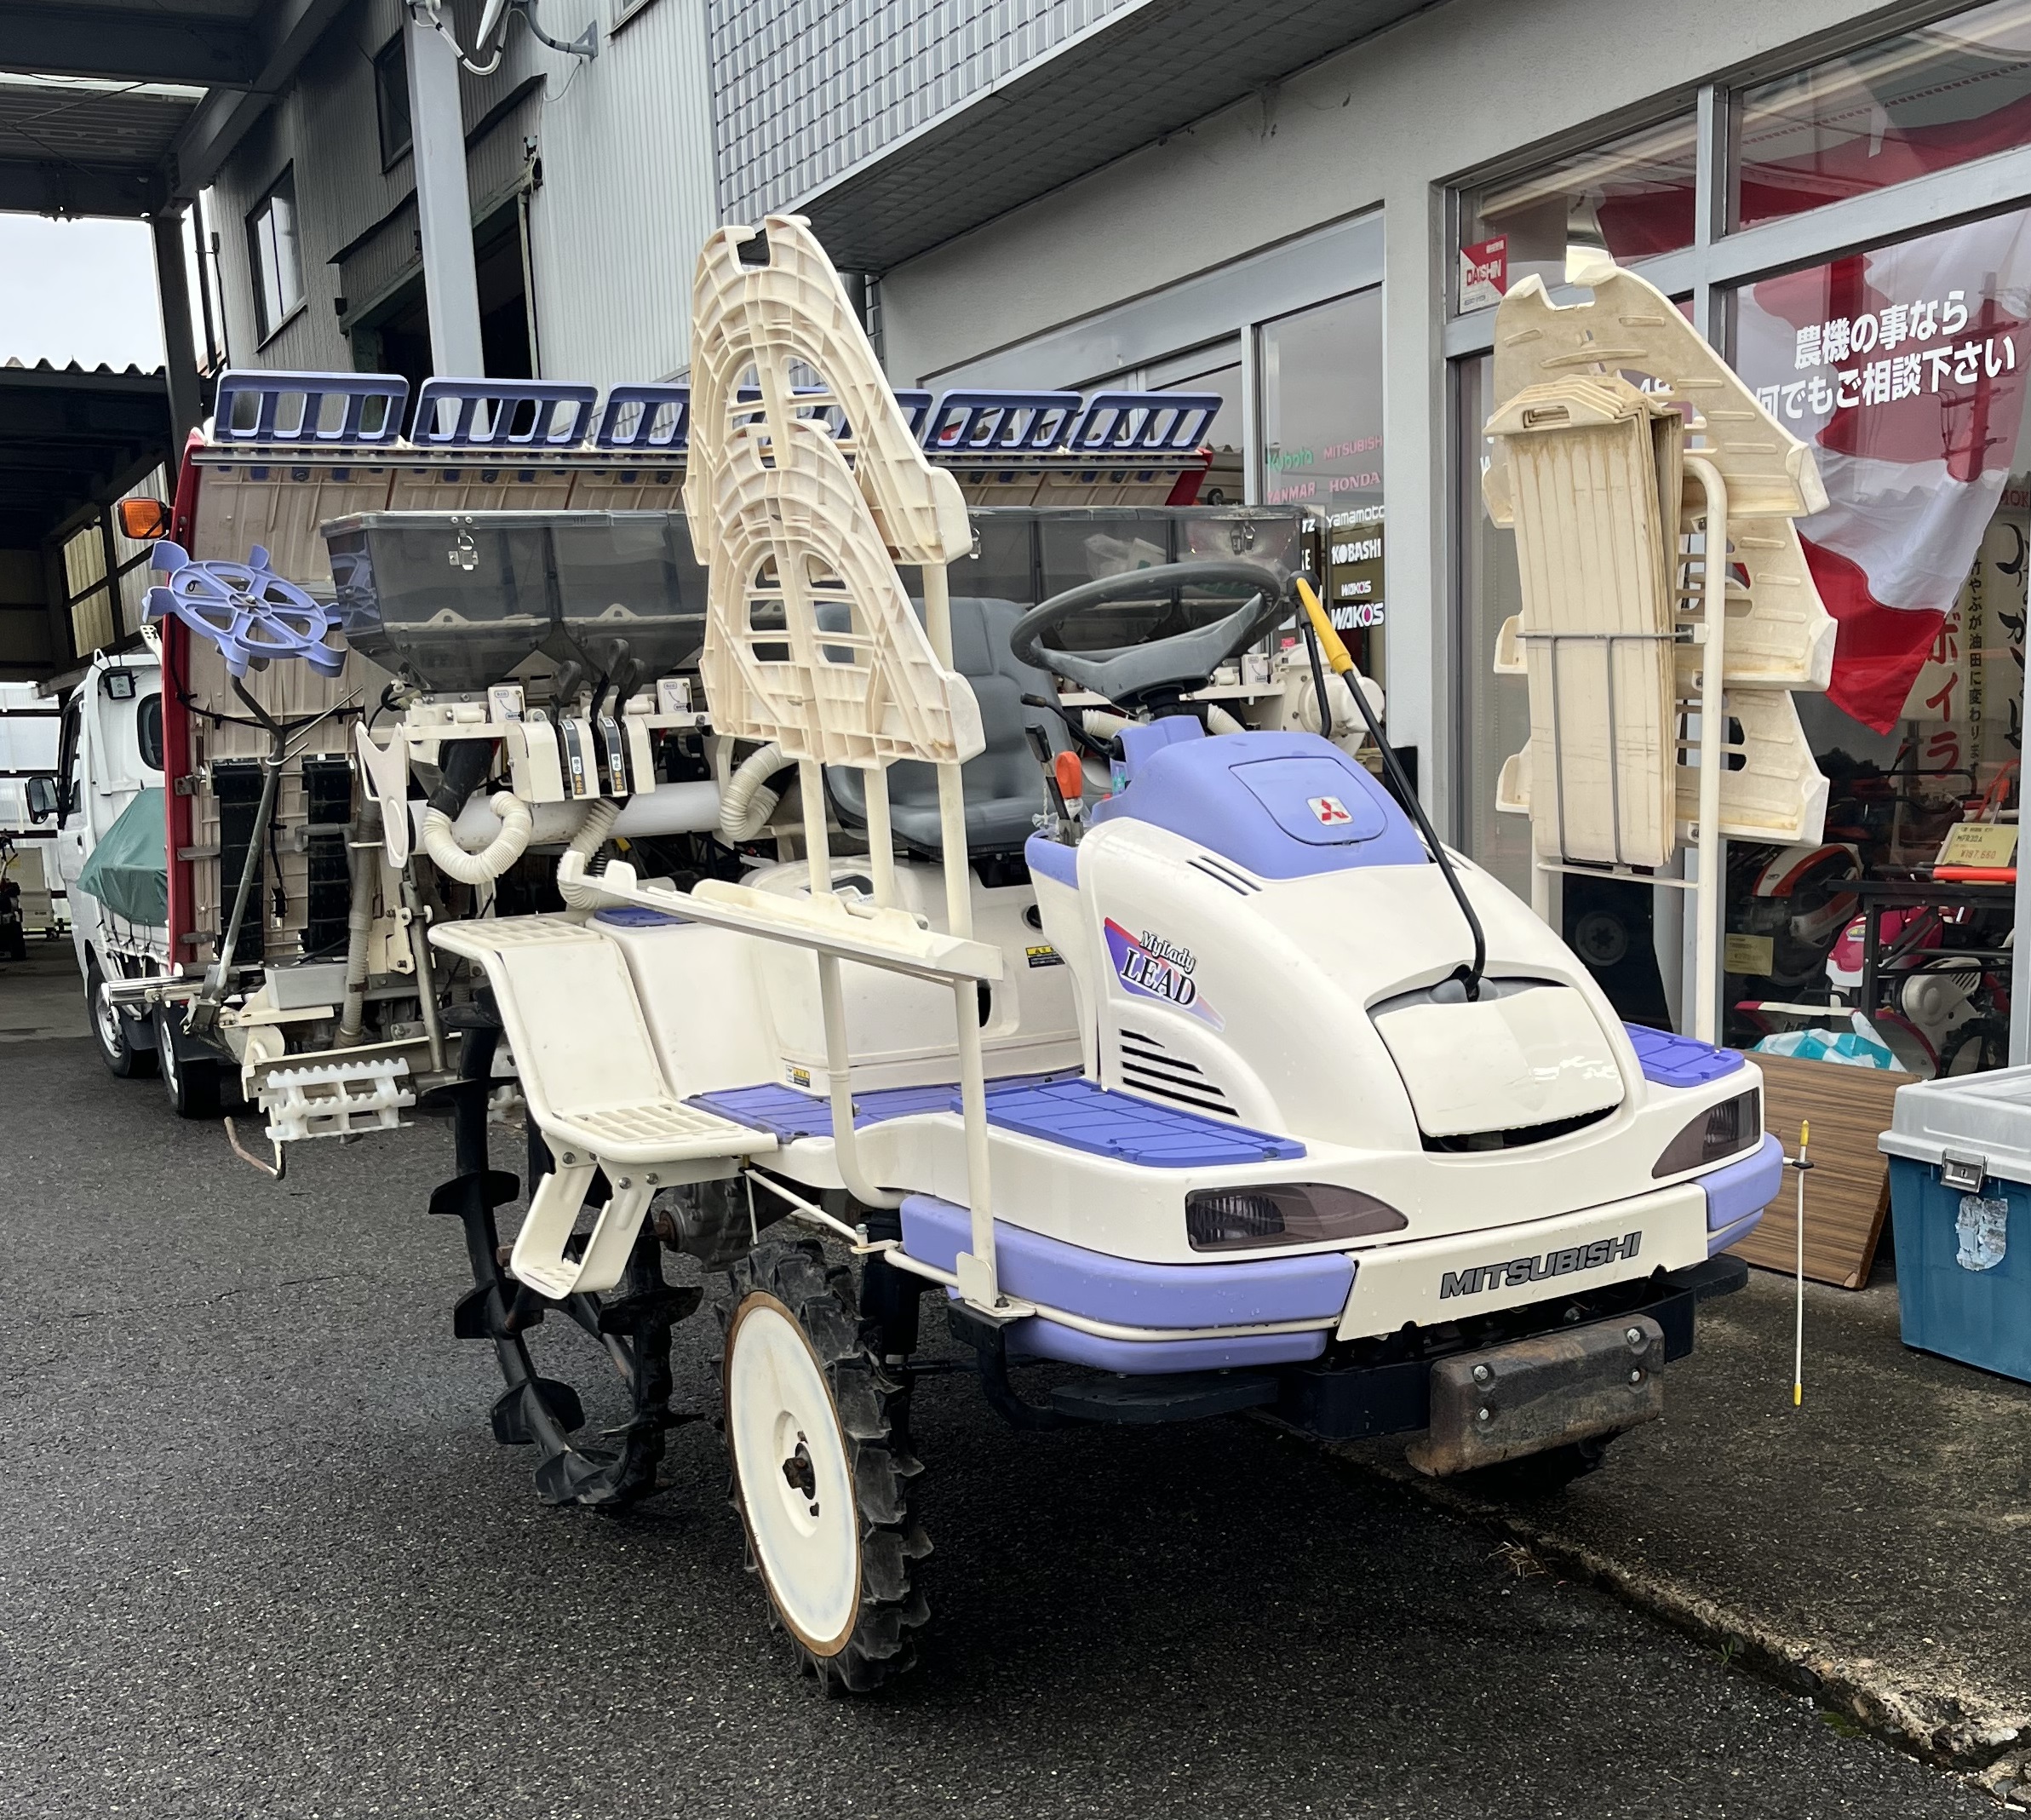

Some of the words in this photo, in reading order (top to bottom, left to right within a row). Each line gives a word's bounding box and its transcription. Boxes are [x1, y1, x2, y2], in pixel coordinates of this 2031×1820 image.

[1793, 290, 1968, 370] 農機の事なら
[1756, 336, 2016, 422] 何でもご相談下さい
[1268, 447, 1314, 471] Kubota
[1267, 481, 1317, 504] YANMAR
[1329, 472, 1381, 493] HONDA
[1331, 538, 1382, 566] KOBASHI
[1121, 948, 1197, 1007] LEAD
[1440, 1231, 1642, 1299] MITSUBISHI
